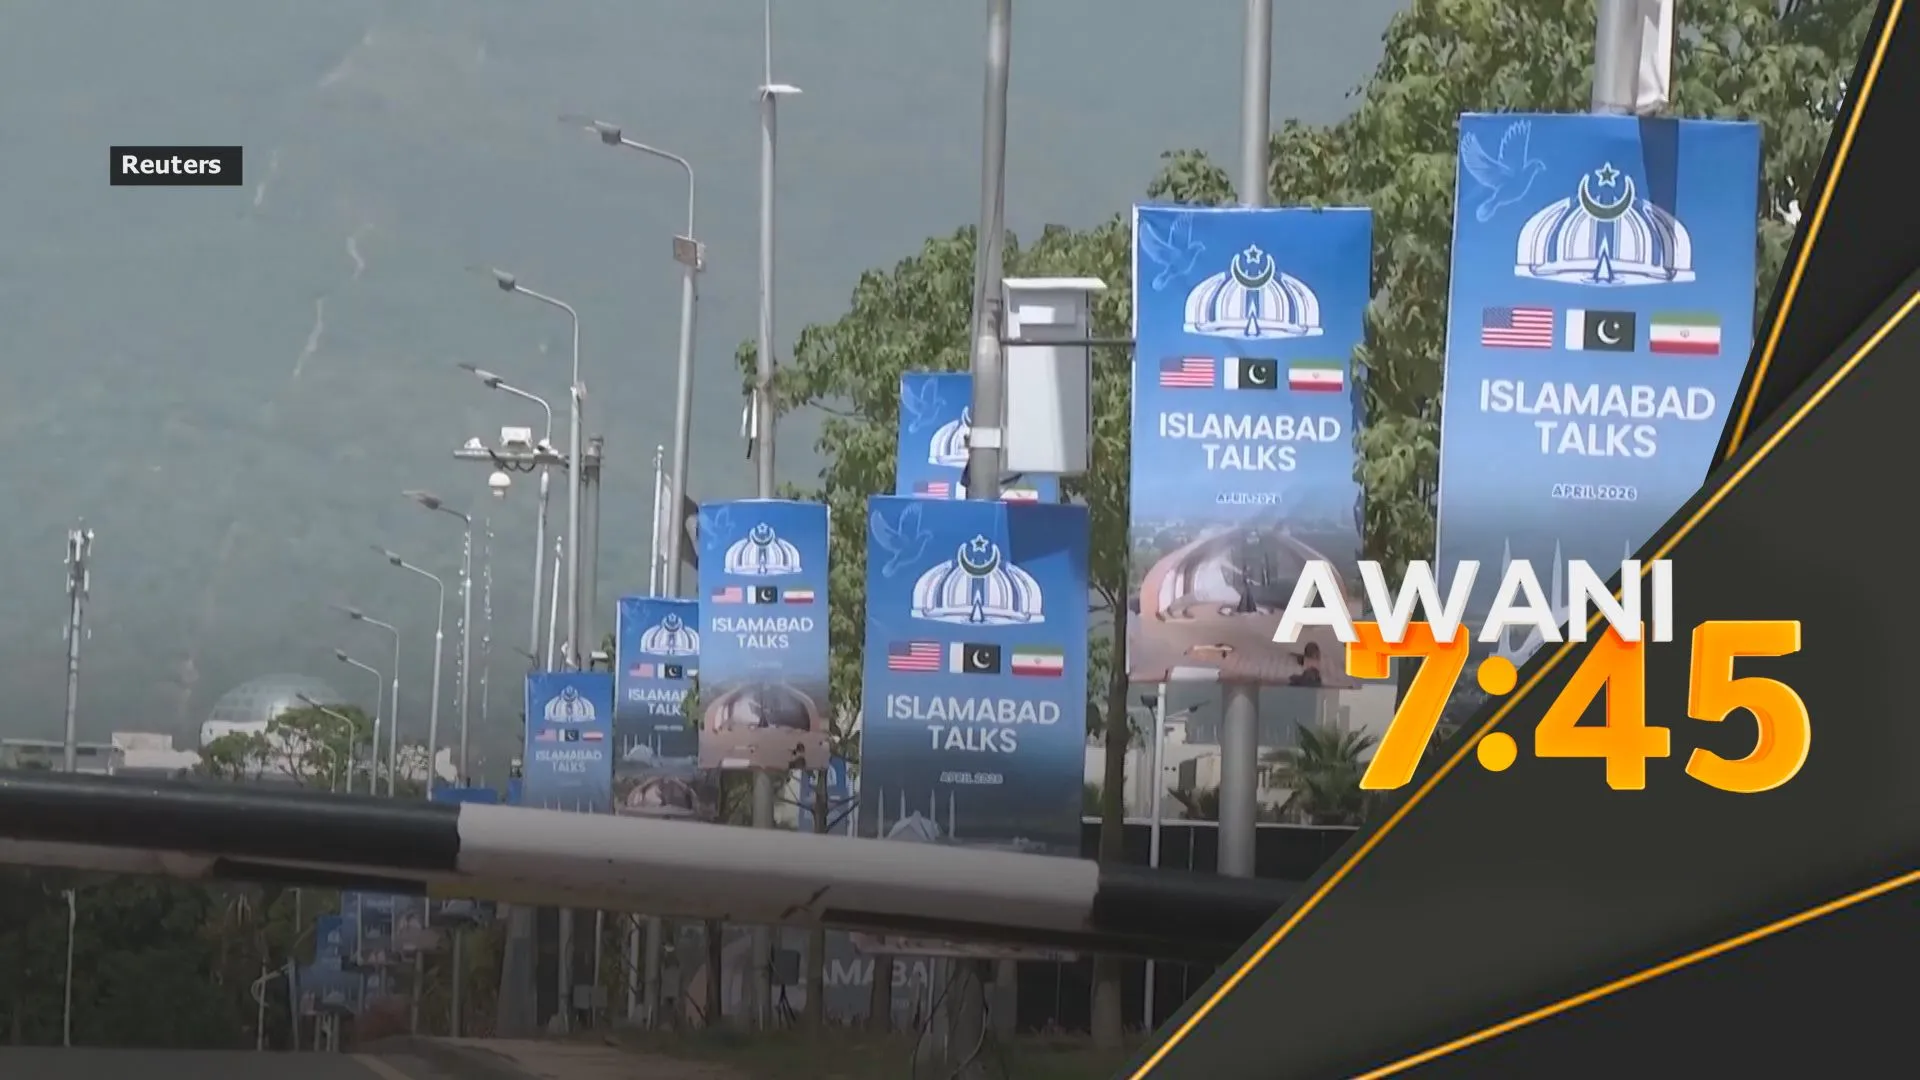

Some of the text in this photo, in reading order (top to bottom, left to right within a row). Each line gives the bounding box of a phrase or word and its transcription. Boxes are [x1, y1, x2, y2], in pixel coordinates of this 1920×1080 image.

[1480, 378, 1716, 421] ISLAMABAD
[1159, 412, 1341, 442] ISLAMABAD
[1534, 420, 1657, 458] TALKS
[1201, 443, 1297, 472] TALKS
[1551, 483, 1638, 501] APRIL 2026
[712, 616, 813, 634] ISLAMABAD
[736, 634, 789, 648] TALKS
[648, 703, 683, 717] TALK
[886, 694, 1061, 725] ISLAMABAD
[927, 725, 1017, 753] TALKS
[535, 749, 603, 761] ISLAMABAD
[552, 760, 586, 773] TALKS
